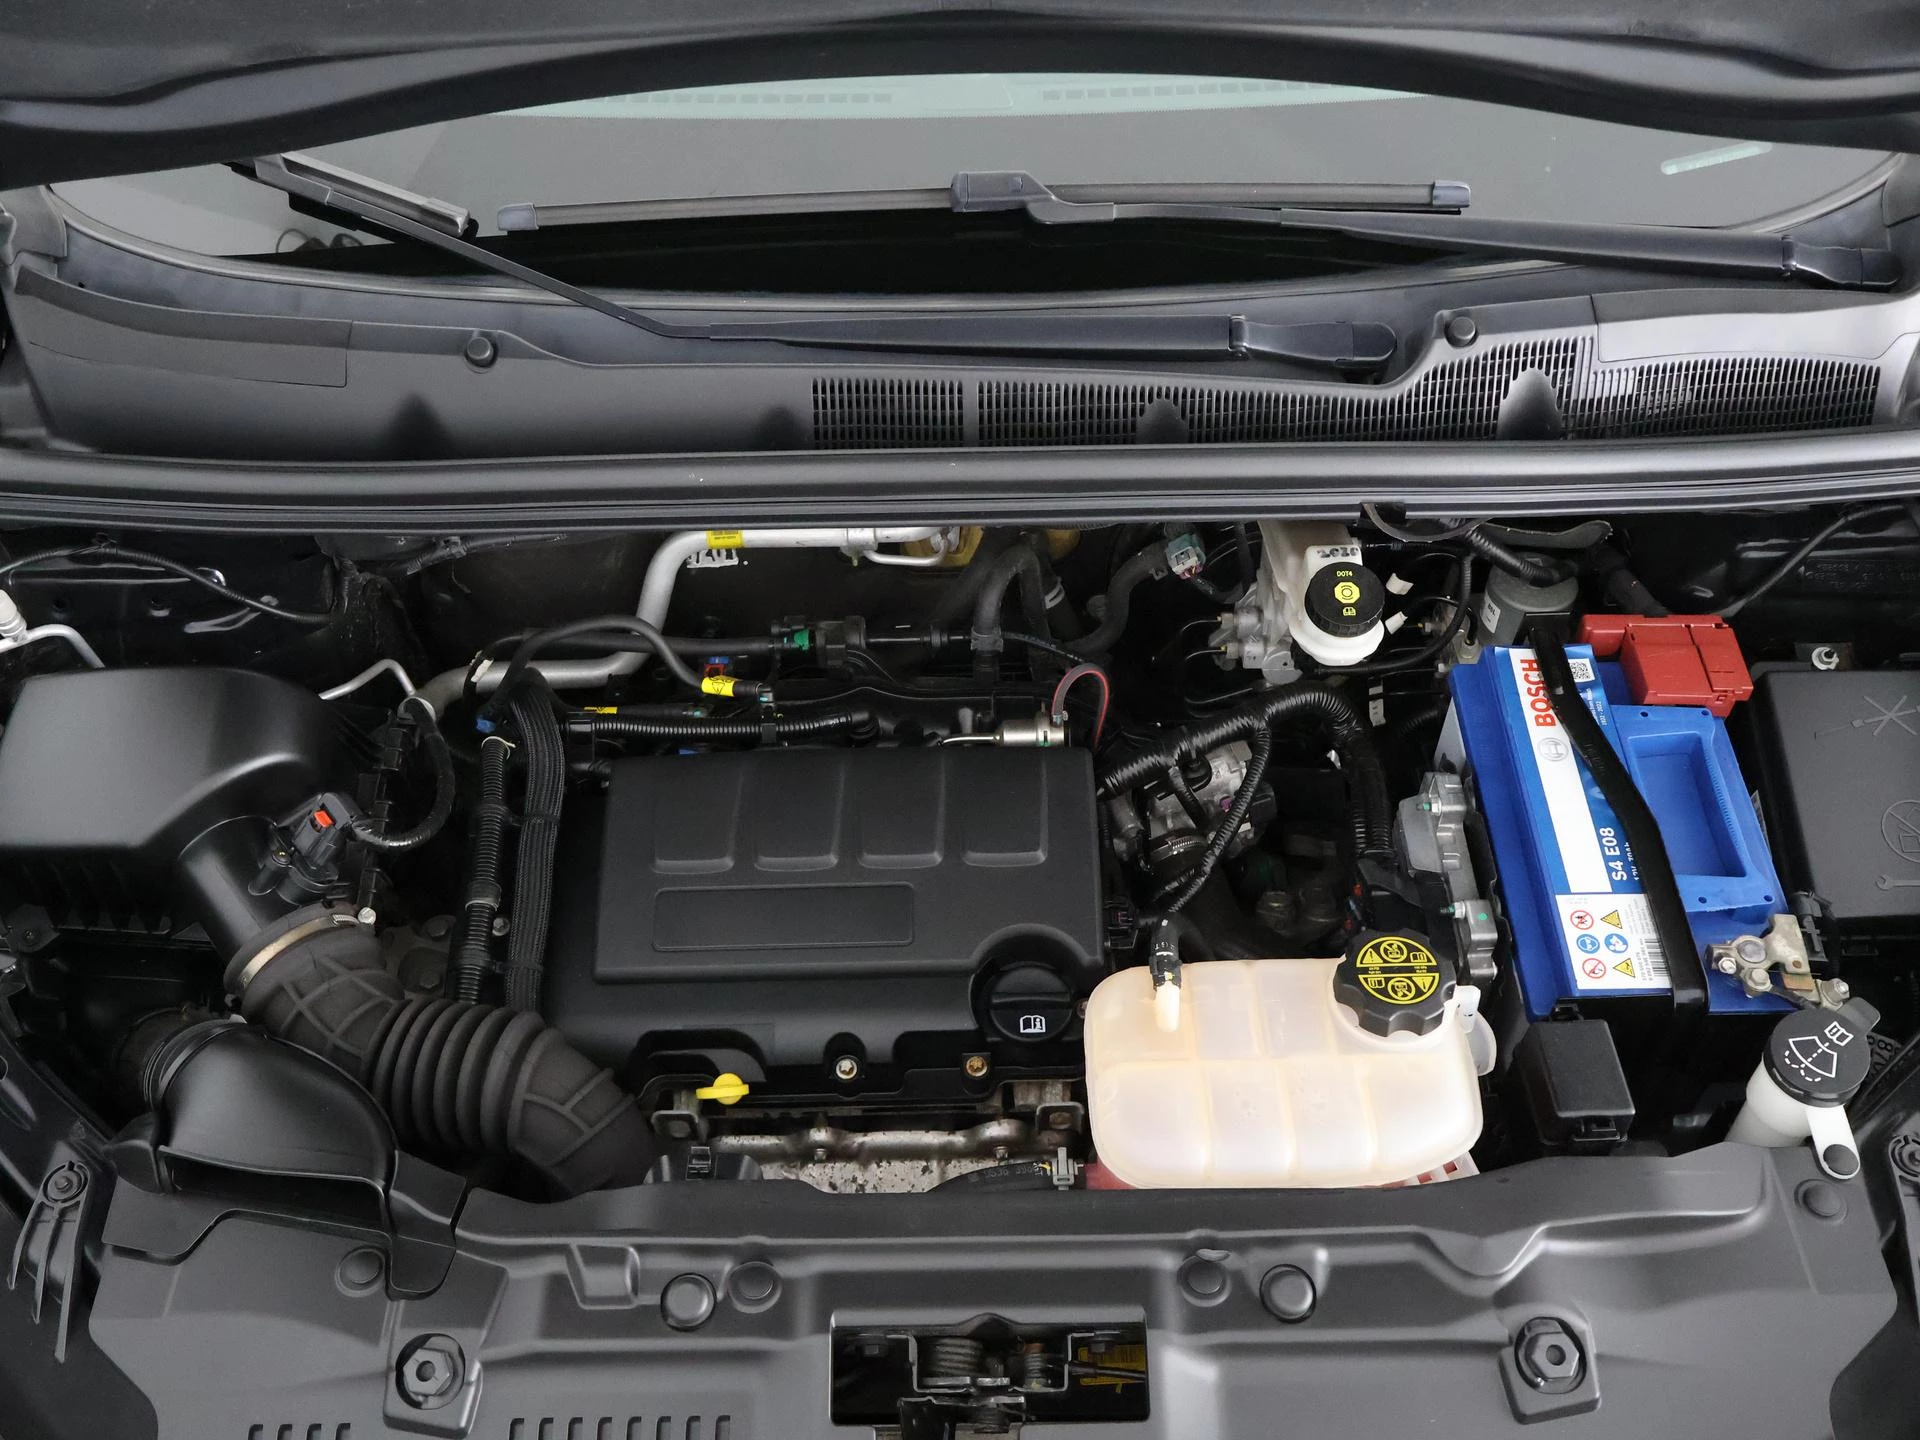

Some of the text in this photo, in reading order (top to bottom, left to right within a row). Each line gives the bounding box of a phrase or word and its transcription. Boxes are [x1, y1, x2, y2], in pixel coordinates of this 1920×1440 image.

[1520, 659, 1556, 727] BOSCH
[1599, 827, 1627, 881] S4 E08
